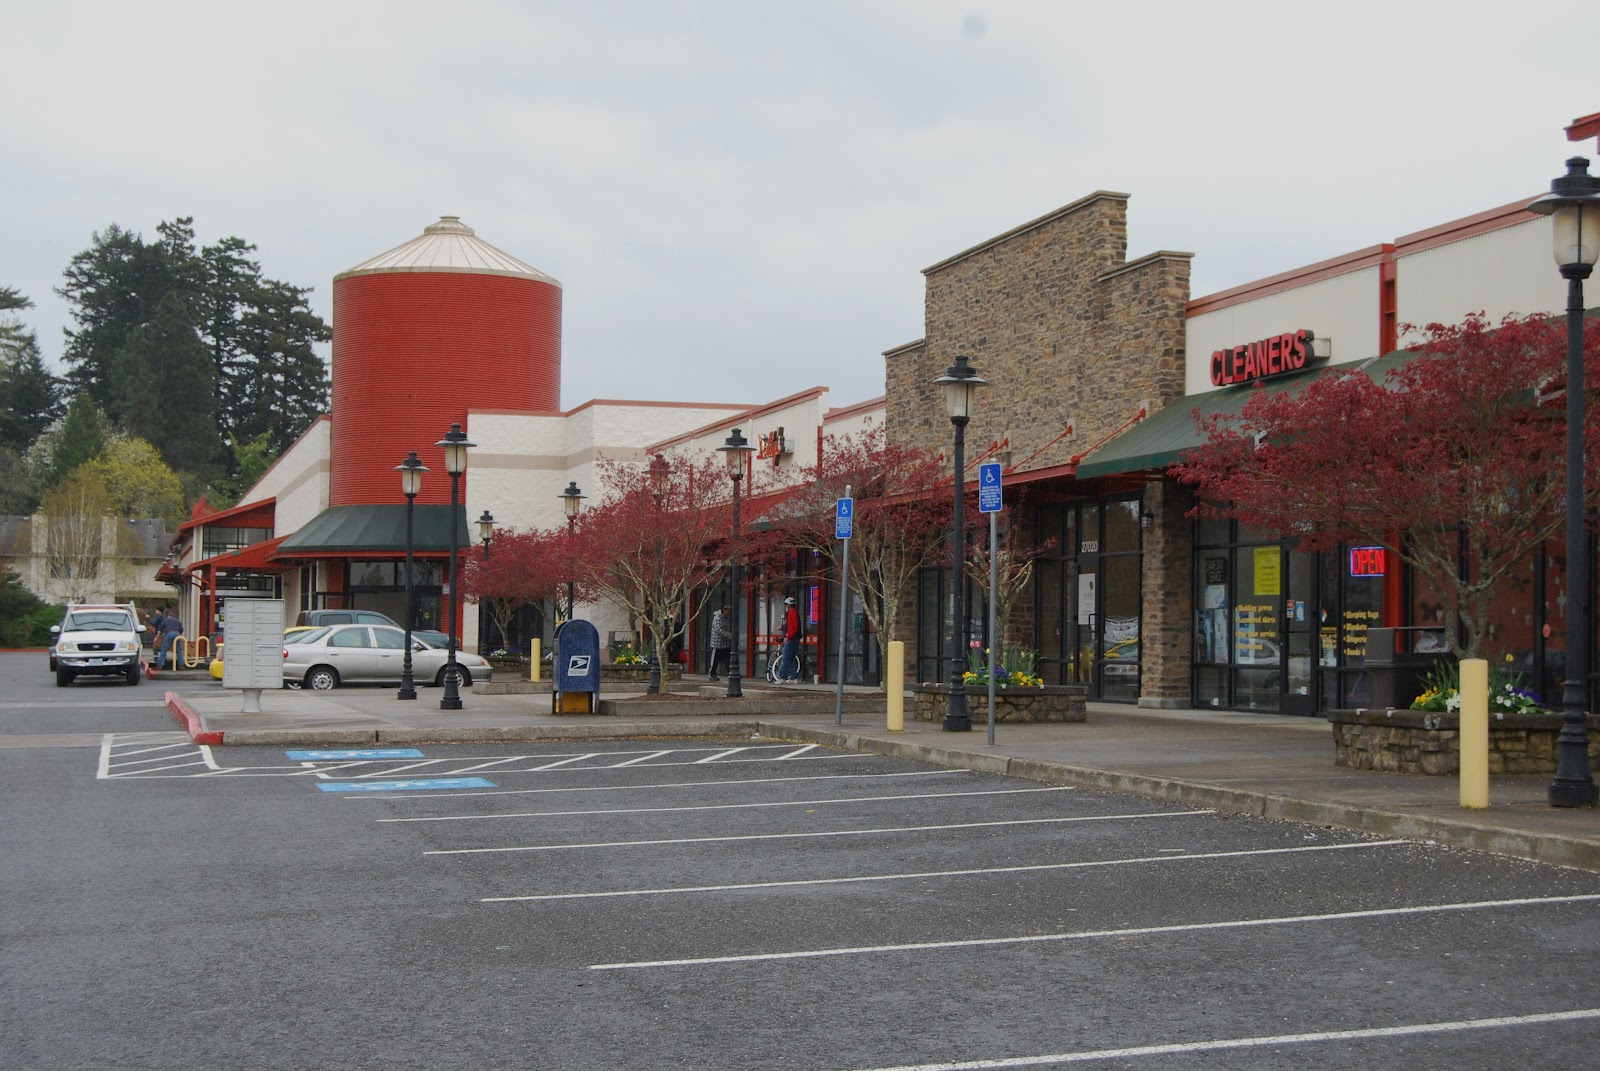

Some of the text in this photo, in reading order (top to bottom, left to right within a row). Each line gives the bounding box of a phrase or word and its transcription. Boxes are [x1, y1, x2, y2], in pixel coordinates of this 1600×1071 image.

[1210, 328, 1309, 386] CLEANERS
[1081, 540, 1098, 553] 27020
[1352, 549, 1385, 574] OPEN
[1346, 634, 1367, 644] Draperie
